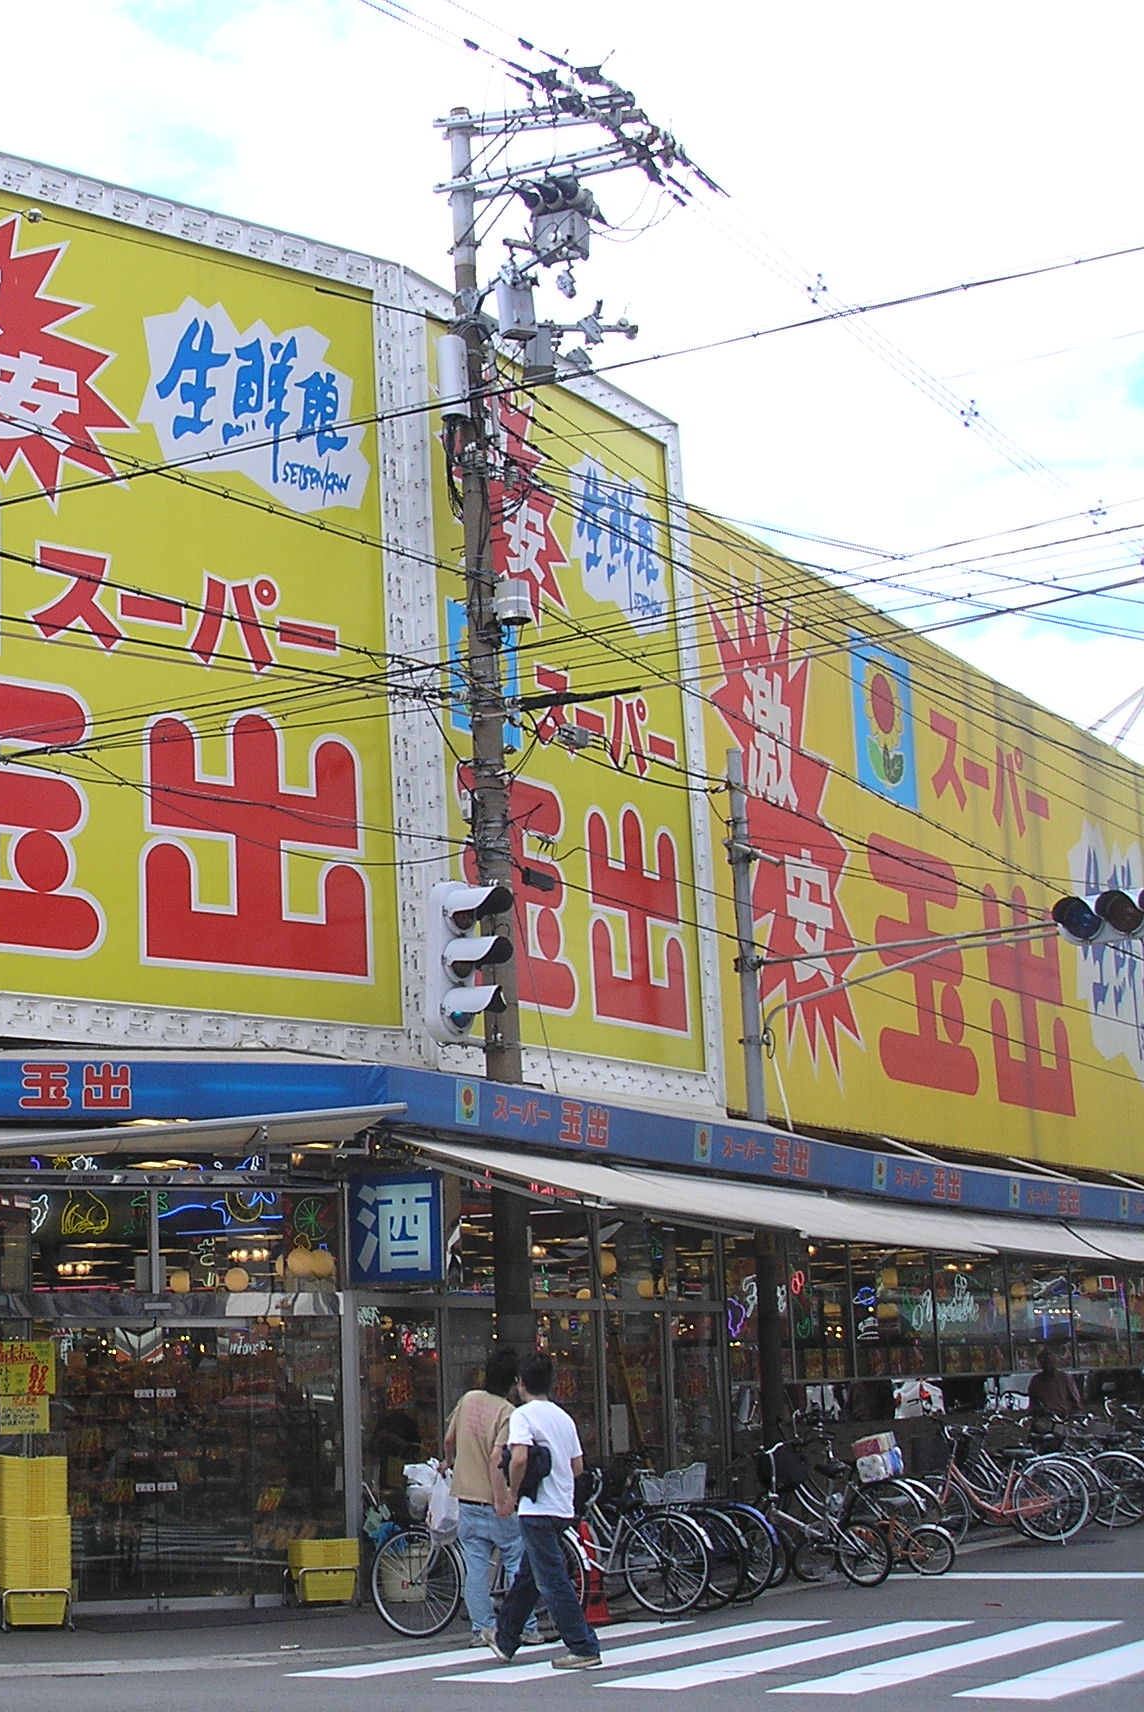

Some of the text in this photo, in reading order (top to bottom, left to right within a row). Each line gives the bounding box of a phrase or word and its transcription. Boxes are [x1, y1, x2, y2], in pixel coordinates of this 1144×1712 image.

[156, 317, 349, 483] 生鮮館
[26, 541, 340, 674] スーパー
[743, 665, 836, 986] 激安
[929, 709, 1050, 838] スーパー
[866, 832, 1076, 1117] 玉出
[19, 1062, 132, 1109] 玉出
[493, 1096, 610, 1149] スーパー 玉出
[722, 1136, 810, 1178] スーパー 玉出
[932, 1167, 961, 1201] 玉出
[357, 1182, 433, 1272] 酒
